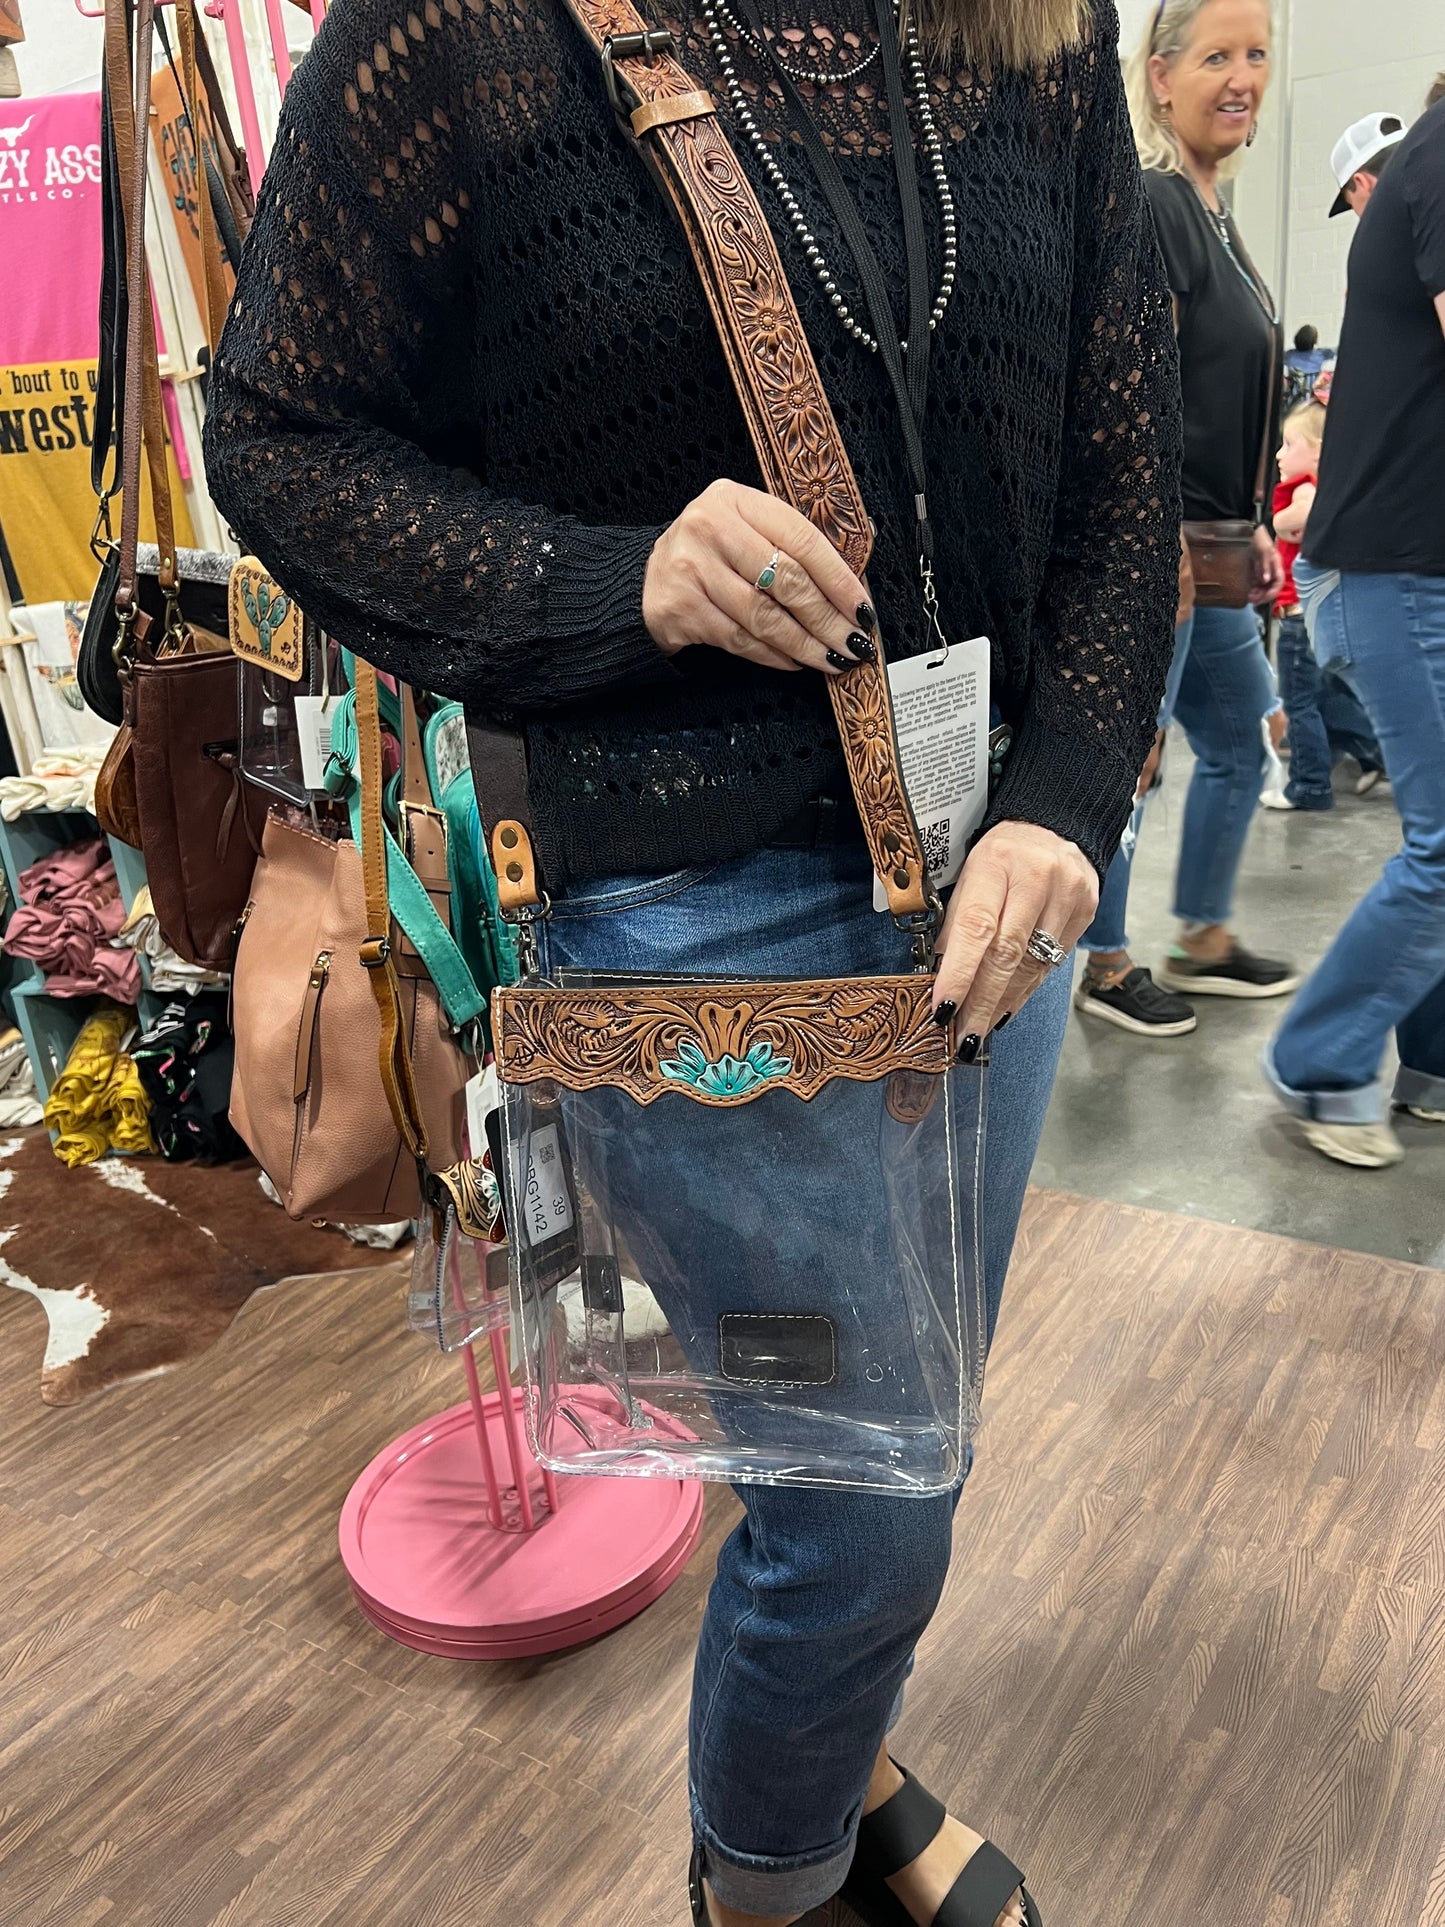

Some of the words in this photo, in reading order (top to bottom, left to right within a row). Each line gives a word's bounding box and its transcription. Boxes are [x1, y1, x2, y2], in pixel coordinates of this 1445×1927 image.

[44, 144, 101, 186] ASS
[60, 368, 79, 391] to
[552, 1196, 566, 1216] 39
